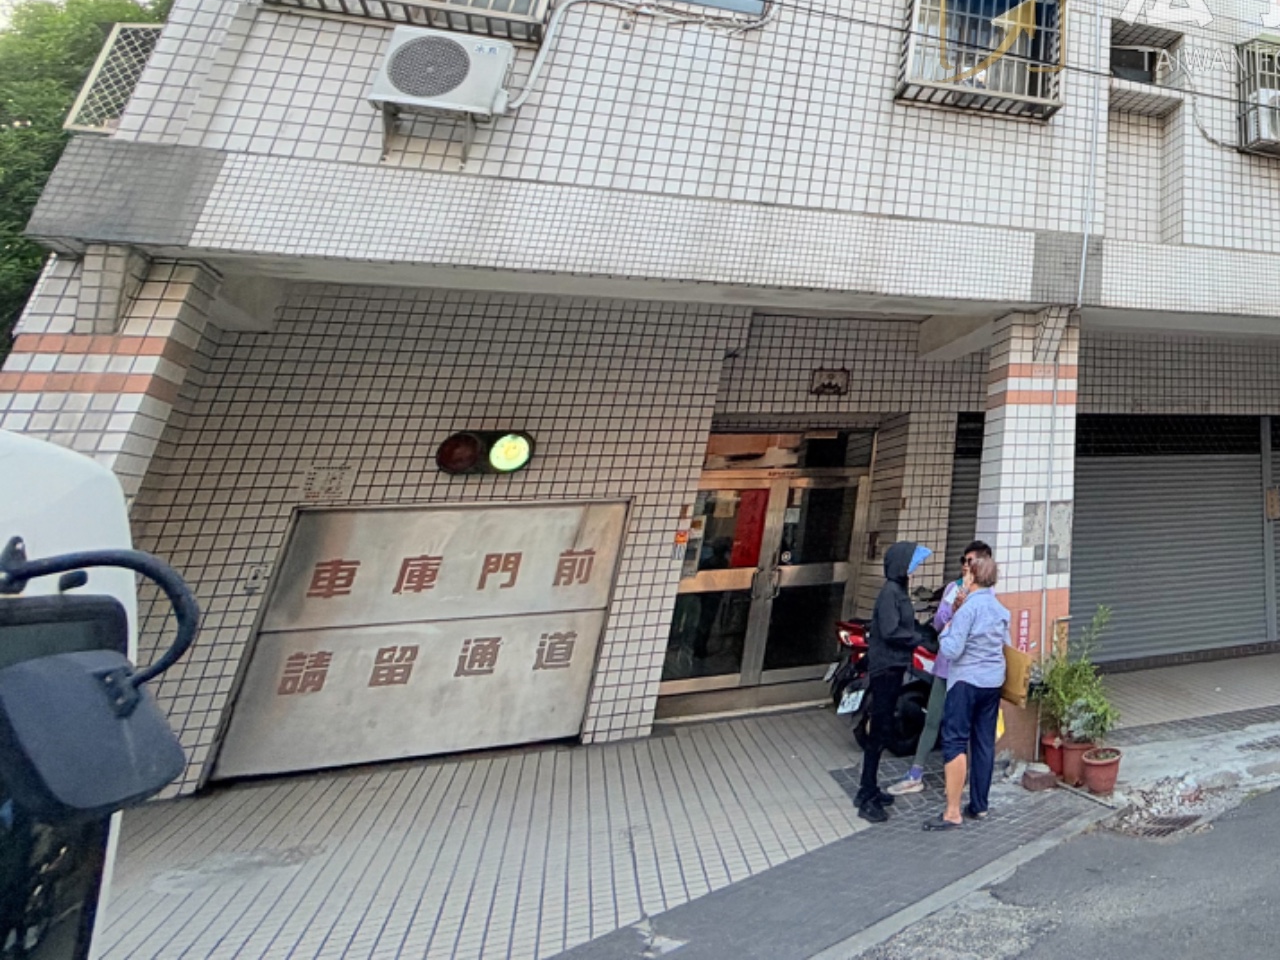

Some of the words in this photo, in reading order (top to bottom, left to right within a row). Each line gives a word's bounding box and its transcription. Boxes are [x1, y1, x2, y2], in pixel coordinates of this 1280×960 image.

[306, 548, 596, 599] 車庫門前
[278, 632, 579, 697] 請留通道
